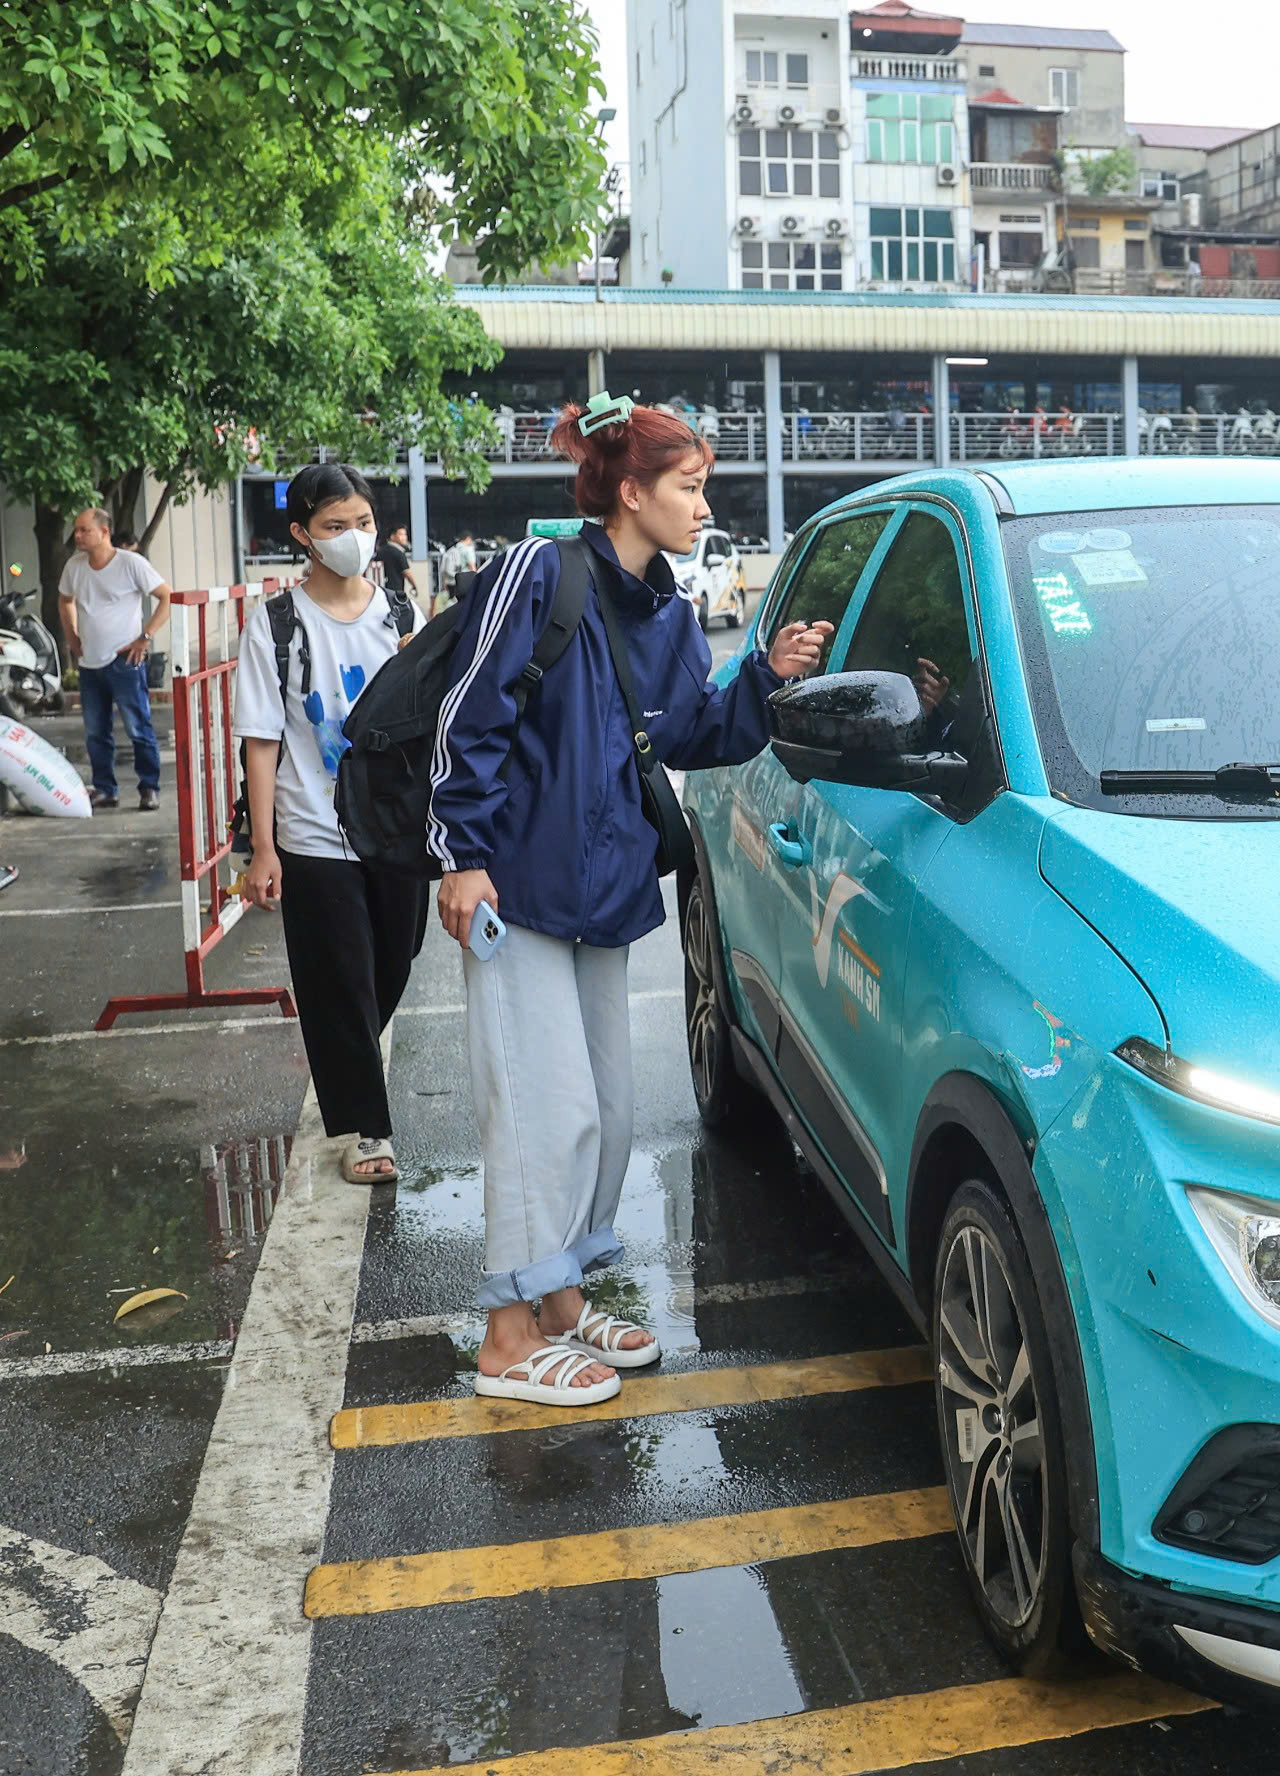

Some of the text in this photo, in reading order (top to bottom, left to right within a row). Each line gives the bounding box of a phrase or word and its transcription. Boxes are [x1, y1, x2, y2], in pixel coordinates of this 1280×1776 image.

[1032, 571, 1092, 633] TAXI
[838, 942, 864, 1004] XANH
[866, 974, 880, 1022] SM
